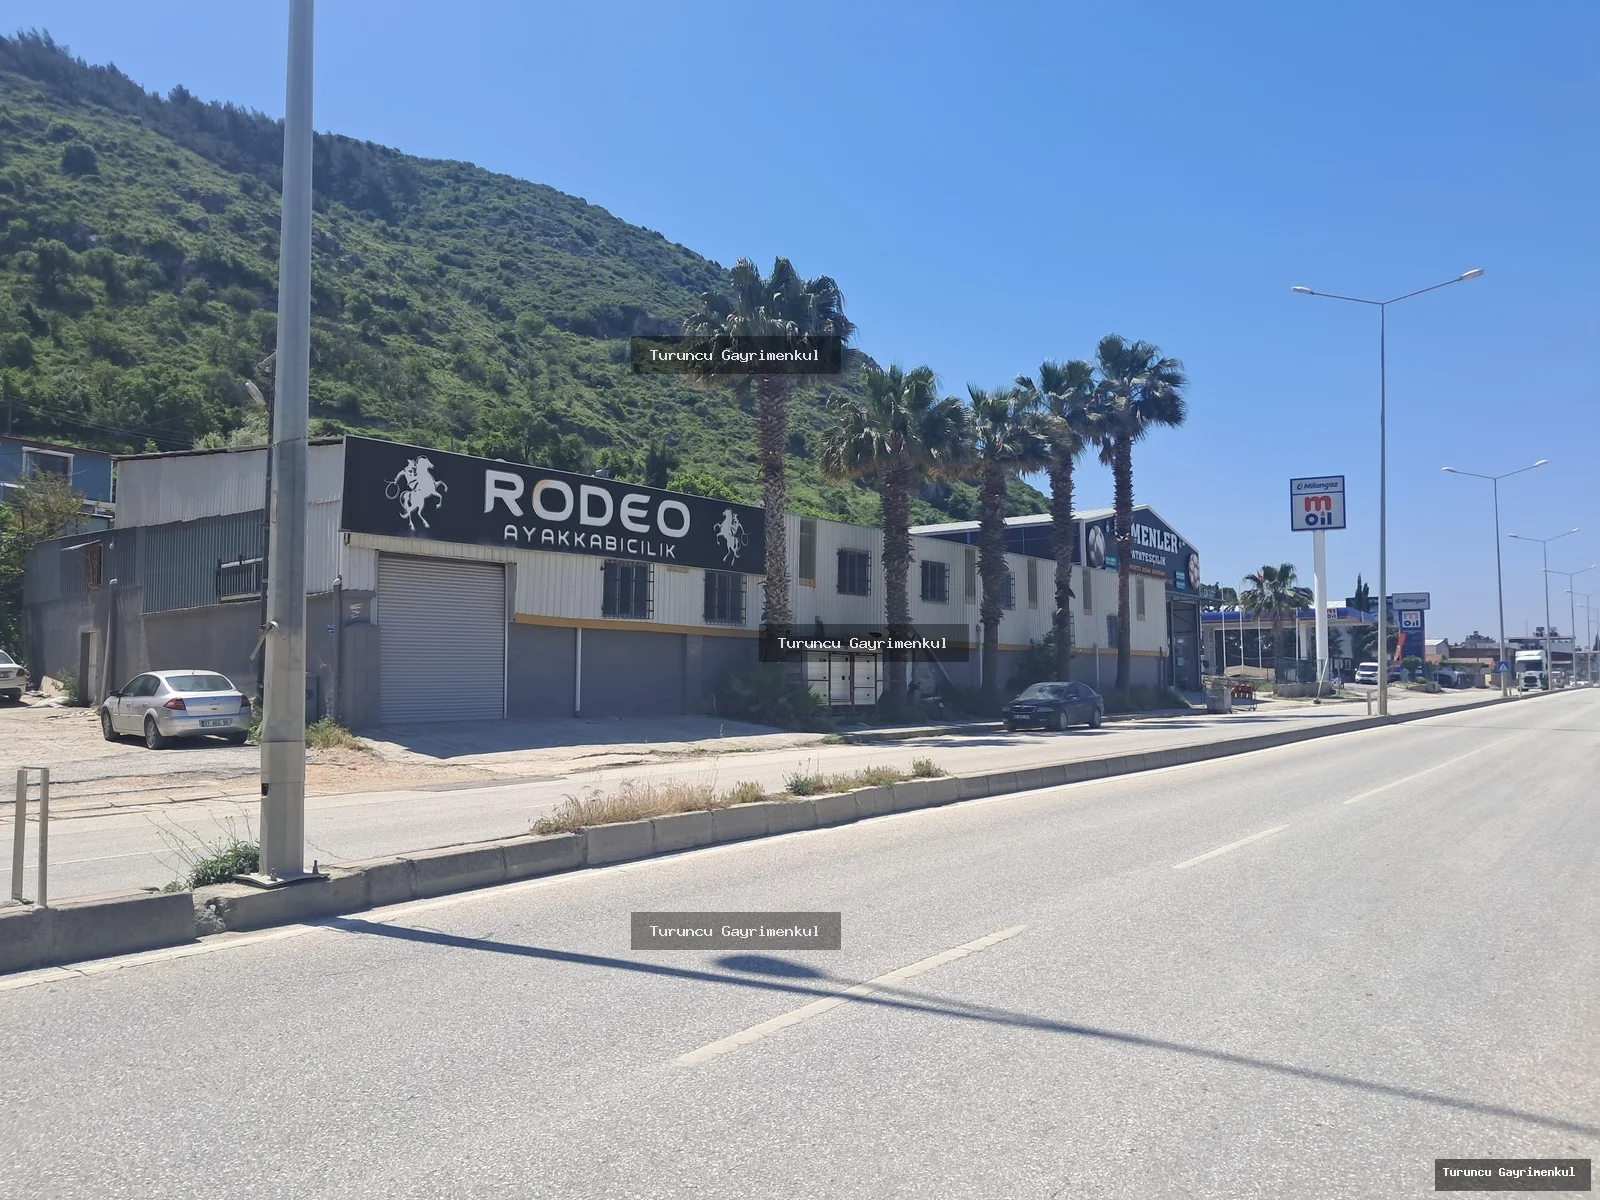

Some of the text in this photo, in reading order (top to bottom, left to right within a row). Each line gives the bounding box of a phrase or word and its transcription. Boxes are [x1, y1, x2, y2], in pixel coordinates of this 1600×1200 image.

[1304, 482, 1338, 490] Milangaz
[484, 469, 691, 538] RODEO
[504, 524, 676, 558] AYAKKABICILIK
